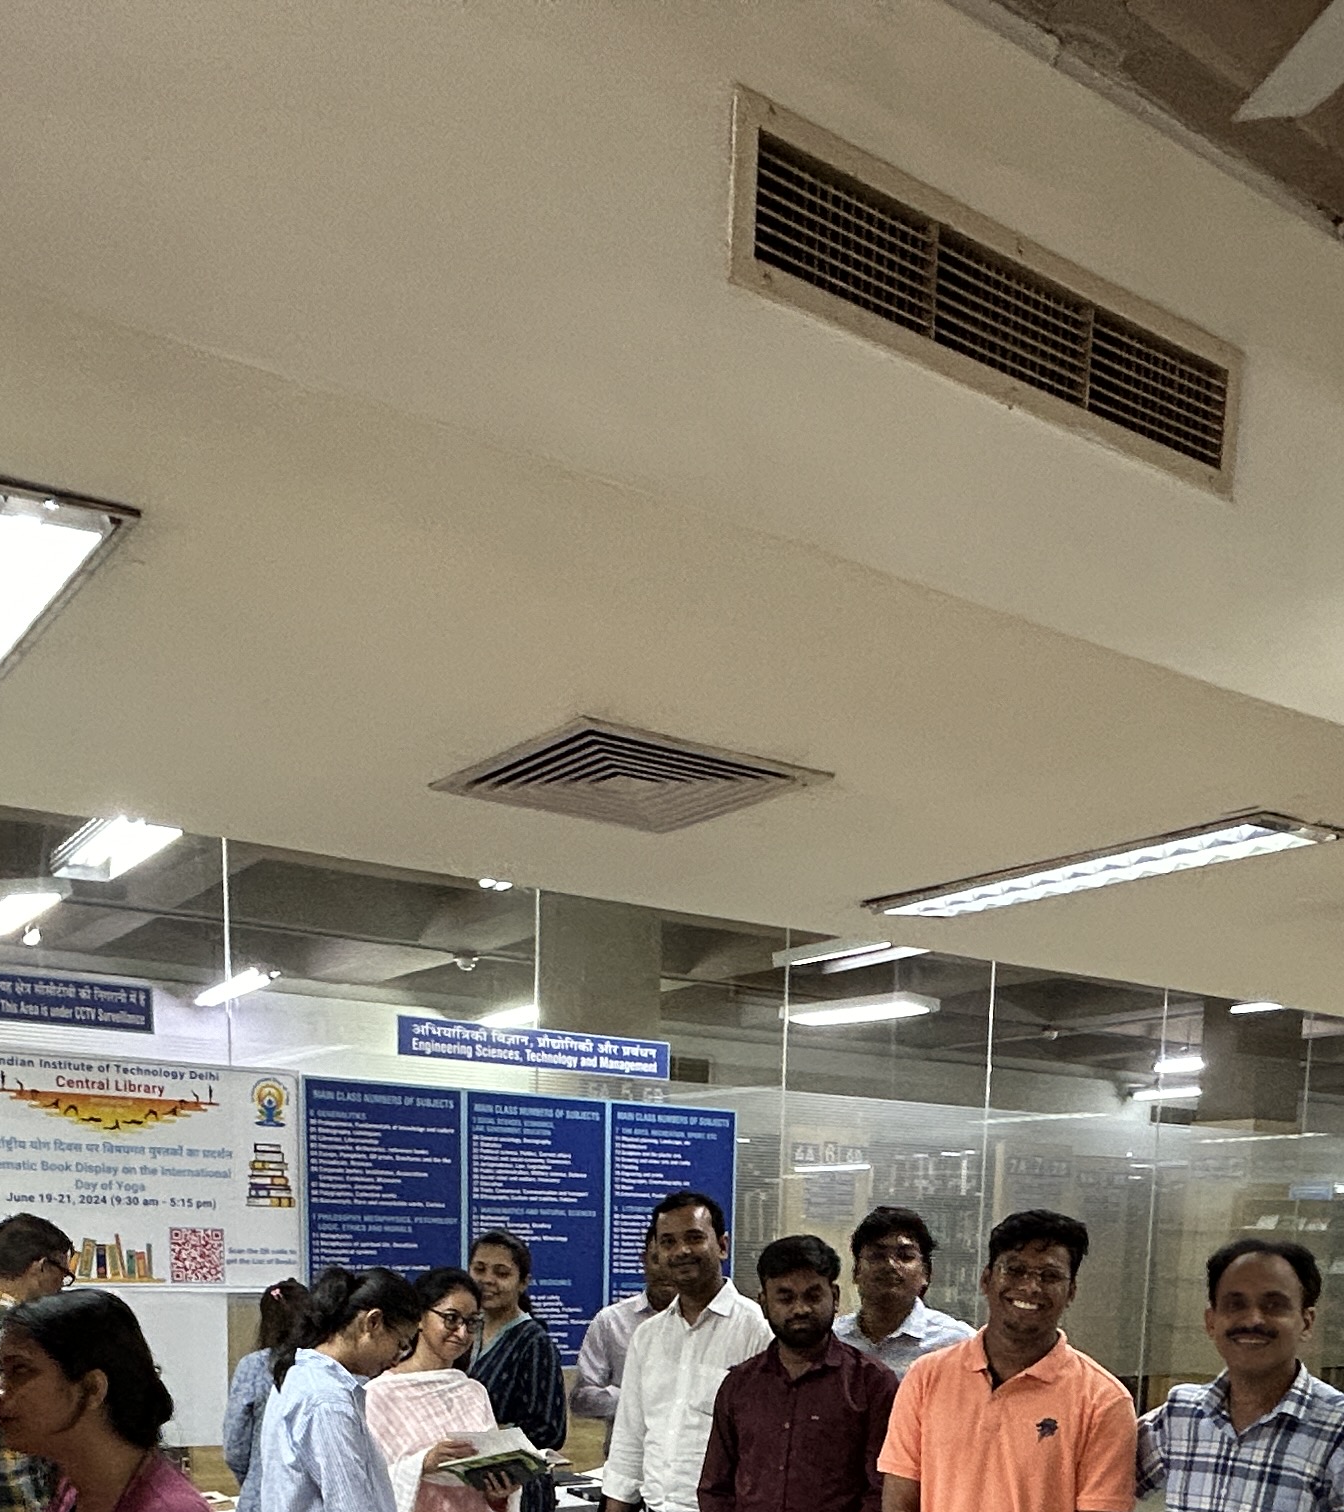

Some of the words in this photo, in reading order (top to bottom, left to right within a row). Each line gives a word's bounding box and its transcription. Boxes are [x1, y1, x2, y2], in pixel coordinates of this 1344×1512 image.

[0, 1000, 18, 1014] This
[20, 1002, 39, 1015] Area
[41, 1004, 49, 1016] is
[75, 1007, 96, 1021] CCTV
[412, 1022, 488, 1042] अभियांत्रिकी
[597, 1038, 619, 1056] और
[412, 1038, 473, 1058] Engineering
[475, 1044, 523, 1062] Sciences,
[526, 1049, 578, 1069] Technology
[580, 1054, 597, 1068] and
[599, 1055, 657, 1074] Management
[39, 1059, 94, 1073] Institute
[98, 1063, 110, 1073] of
[114, 1064, 186, 1081] Technology
[189, 1070, 220, 1082] Delhi
[56, 1075, 110, 1091] Central
[115, 1079, 165, 1096] Library
[336, 1091, 362, 1102] CLASS
[416, 1097, 455, 1110] SUBJECTS
[29, 1139, 50, 1151] योग
[85, 1143, 99, 1153] पर
[41, 1160, 72, 1173] Book
[75, 1161, 118, 1178] Display
[122, 1166, 136, 1175] on
[139, 1164, 157, 1176] the
[160, 1166, 232, 1180] International
[74, 1179, 98, 1193] Day
[100, 1180, 113, 1191] of
[116, 1180, 146, 1194] Yoga
[6, 1192, 35, 1204] June
[38, 1193, 76, 1206] 19-21,
[79, 1194, 107, 1205] 2024
[142, 1197, 159, 1207] am
[169, 1197, 194, 1209] 5:15
[196, 1199, 217, 1211] pm)
